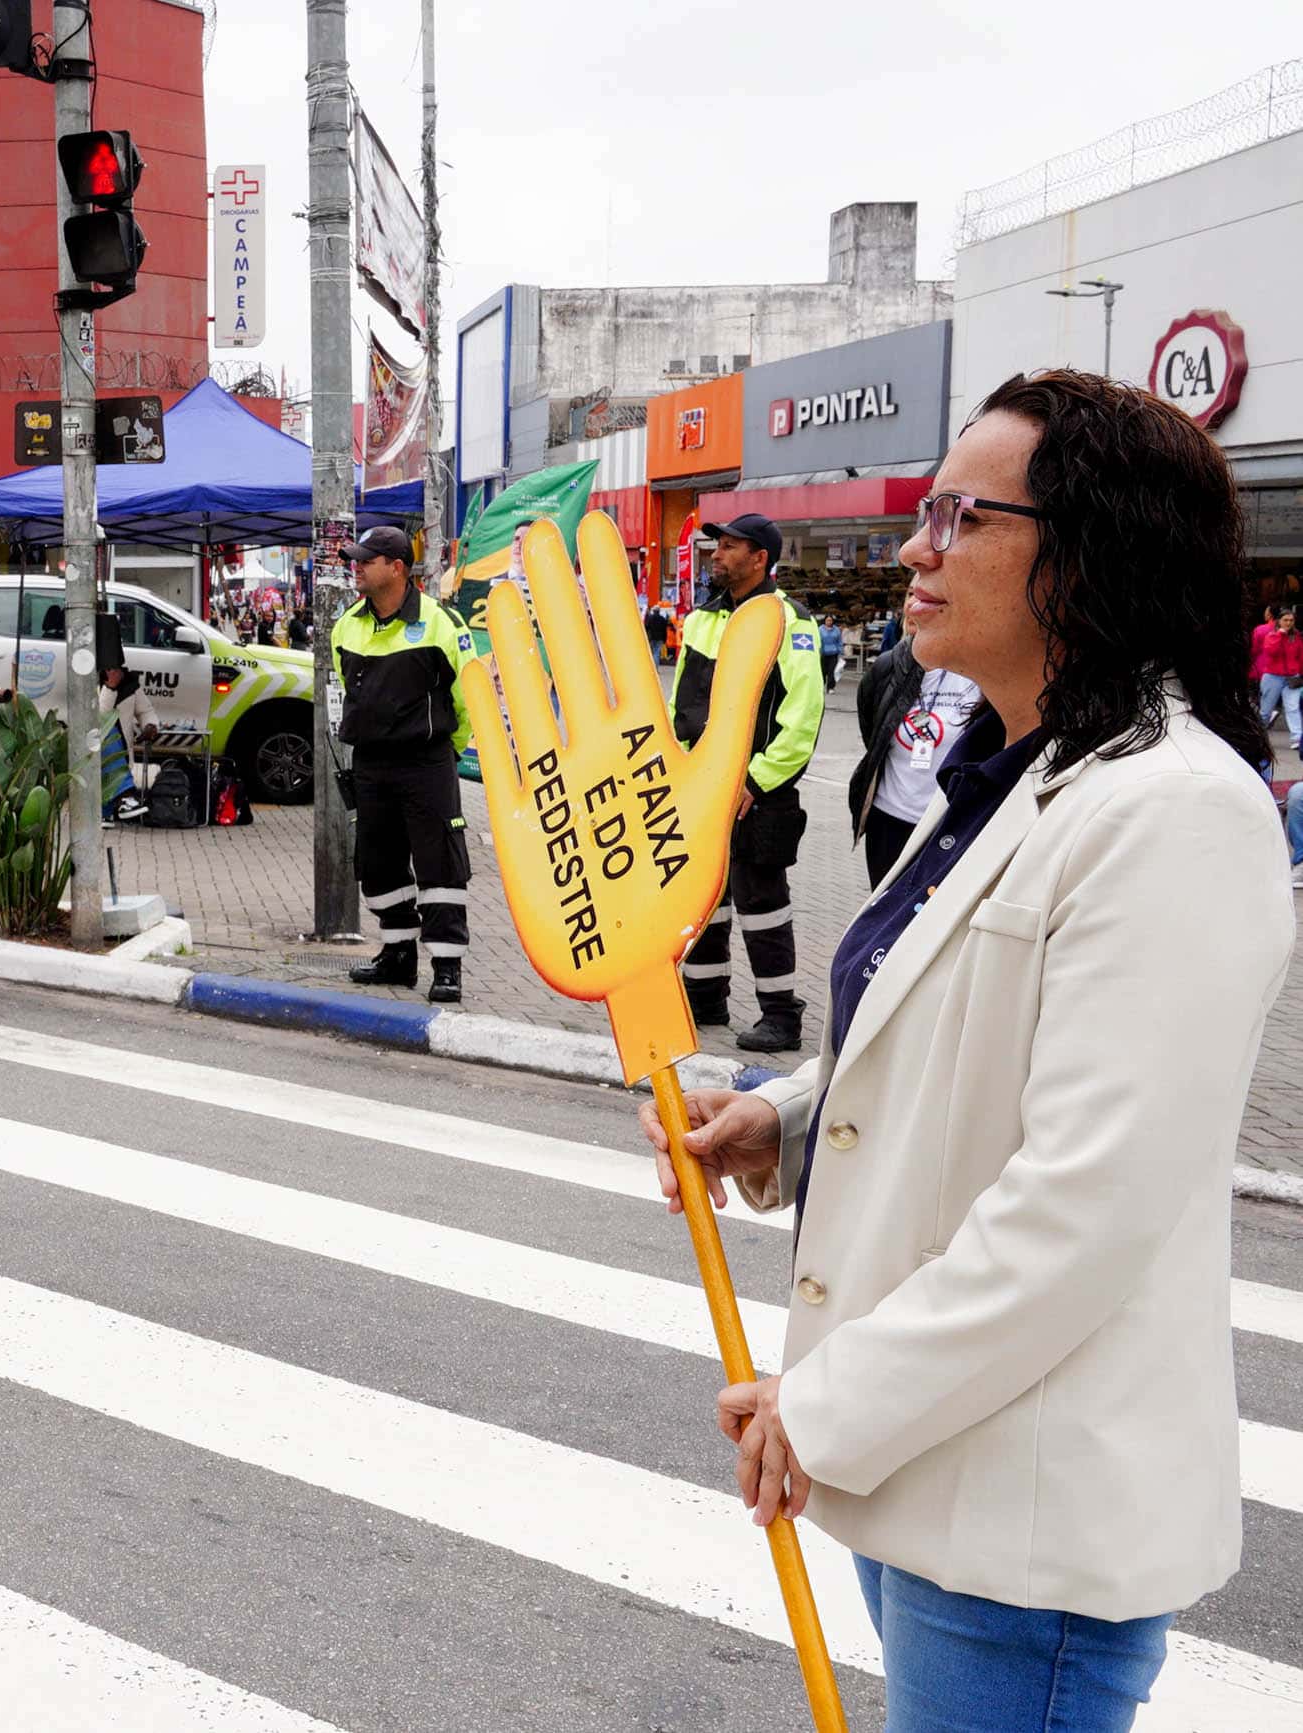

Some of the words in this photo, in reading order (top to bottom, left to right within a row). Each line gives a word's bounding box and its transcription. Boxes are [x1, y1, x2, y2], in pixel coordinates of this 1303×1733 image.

[233, 218, 250, 330] CAMPEÃ
[1164, 345, 1216, 399] C&A
[797, 383, 896, 429] PONTAL
[621, 724, 655, 760] A
[584, 775, 626, 813] É
[632, 754, 689, 889] FAIXA
[527, 748, 605, 970] PEDESTRE
[593, 812, 635, 880] DO
